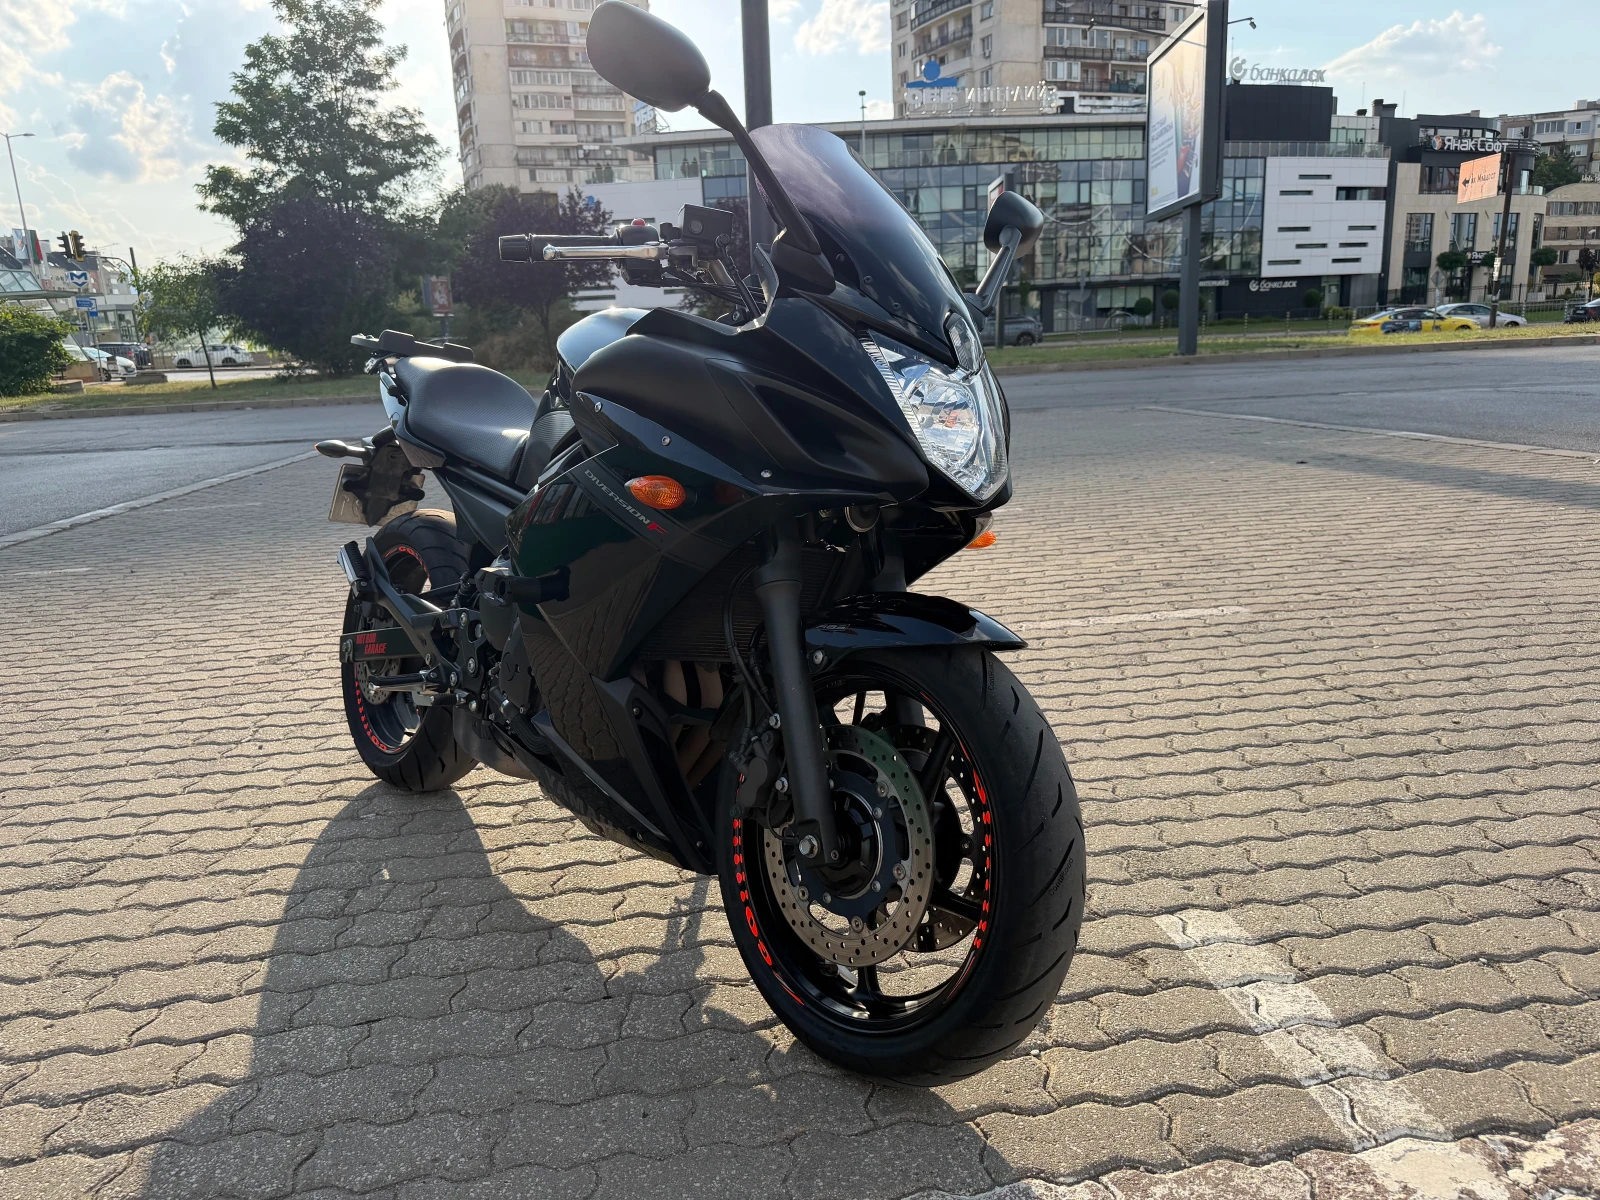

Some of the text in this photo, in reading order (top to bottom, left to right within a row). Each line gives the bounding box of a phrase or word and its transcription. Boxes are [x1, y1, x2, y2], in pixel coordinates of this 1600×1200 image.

[1444, 136, 1475, 151] Янак
[584, 469, 651, 525] DIVERSION
[364, 642, 387, 655] GARAGE
